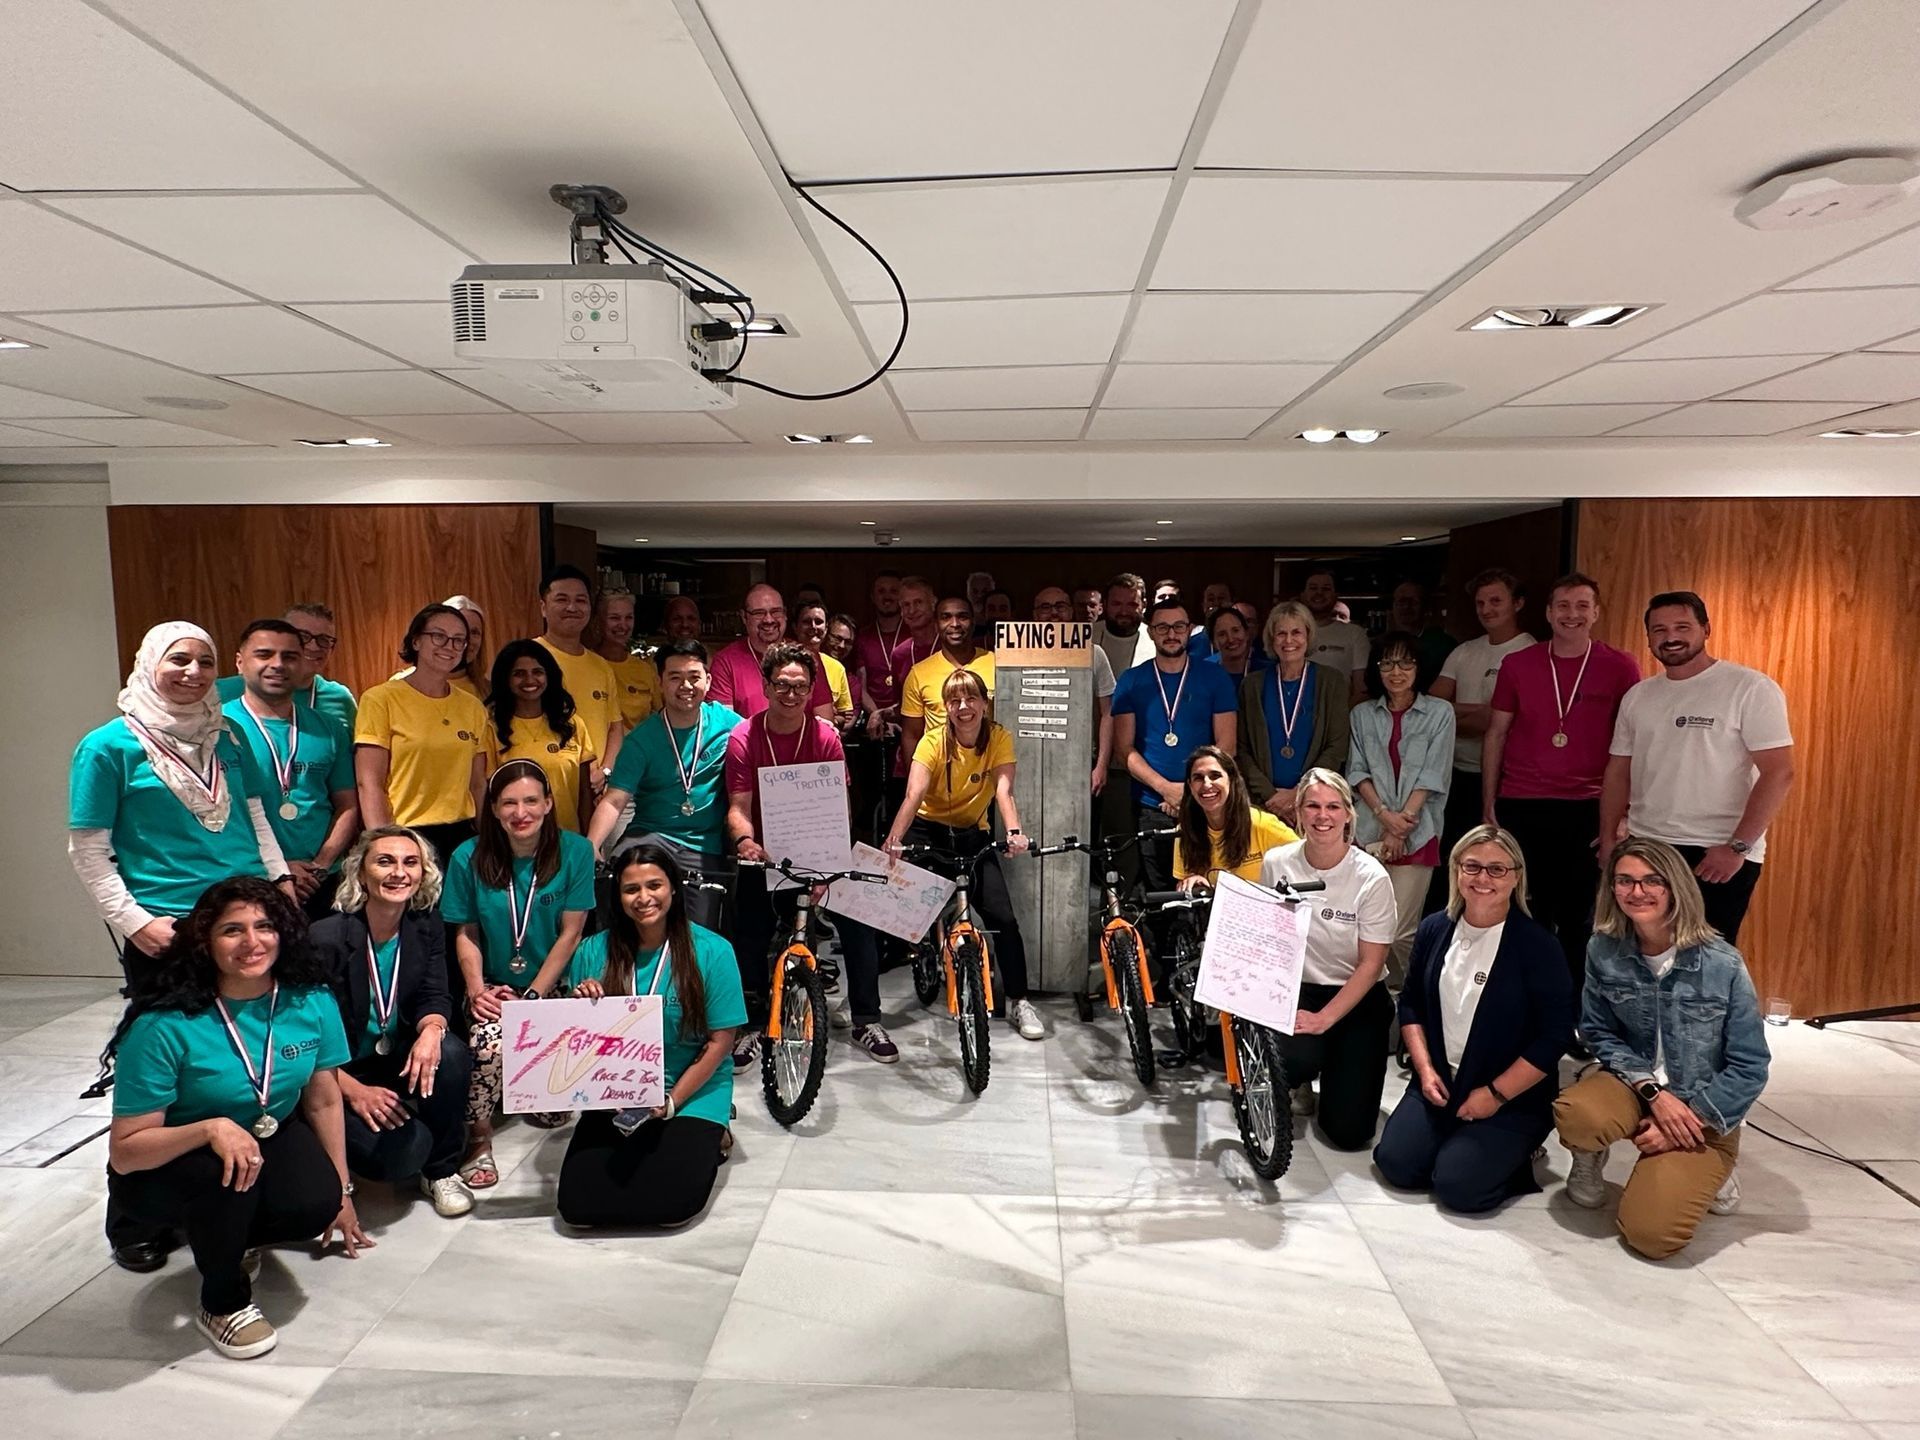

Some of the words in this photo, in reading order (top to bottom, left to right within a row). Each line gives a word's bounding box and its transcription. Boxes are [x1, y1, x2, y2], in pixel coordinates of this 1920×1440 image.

[996, 623, 1055, 649] FLYING
[1060, 623, 1092, 649] LAP
[763, 769, 800, 786] GLOBE
[793, 776, 842, 790] TROTTER
[1335, 910, 1356, 919] Oxford
[621, 1069, 635, 1082] 2
